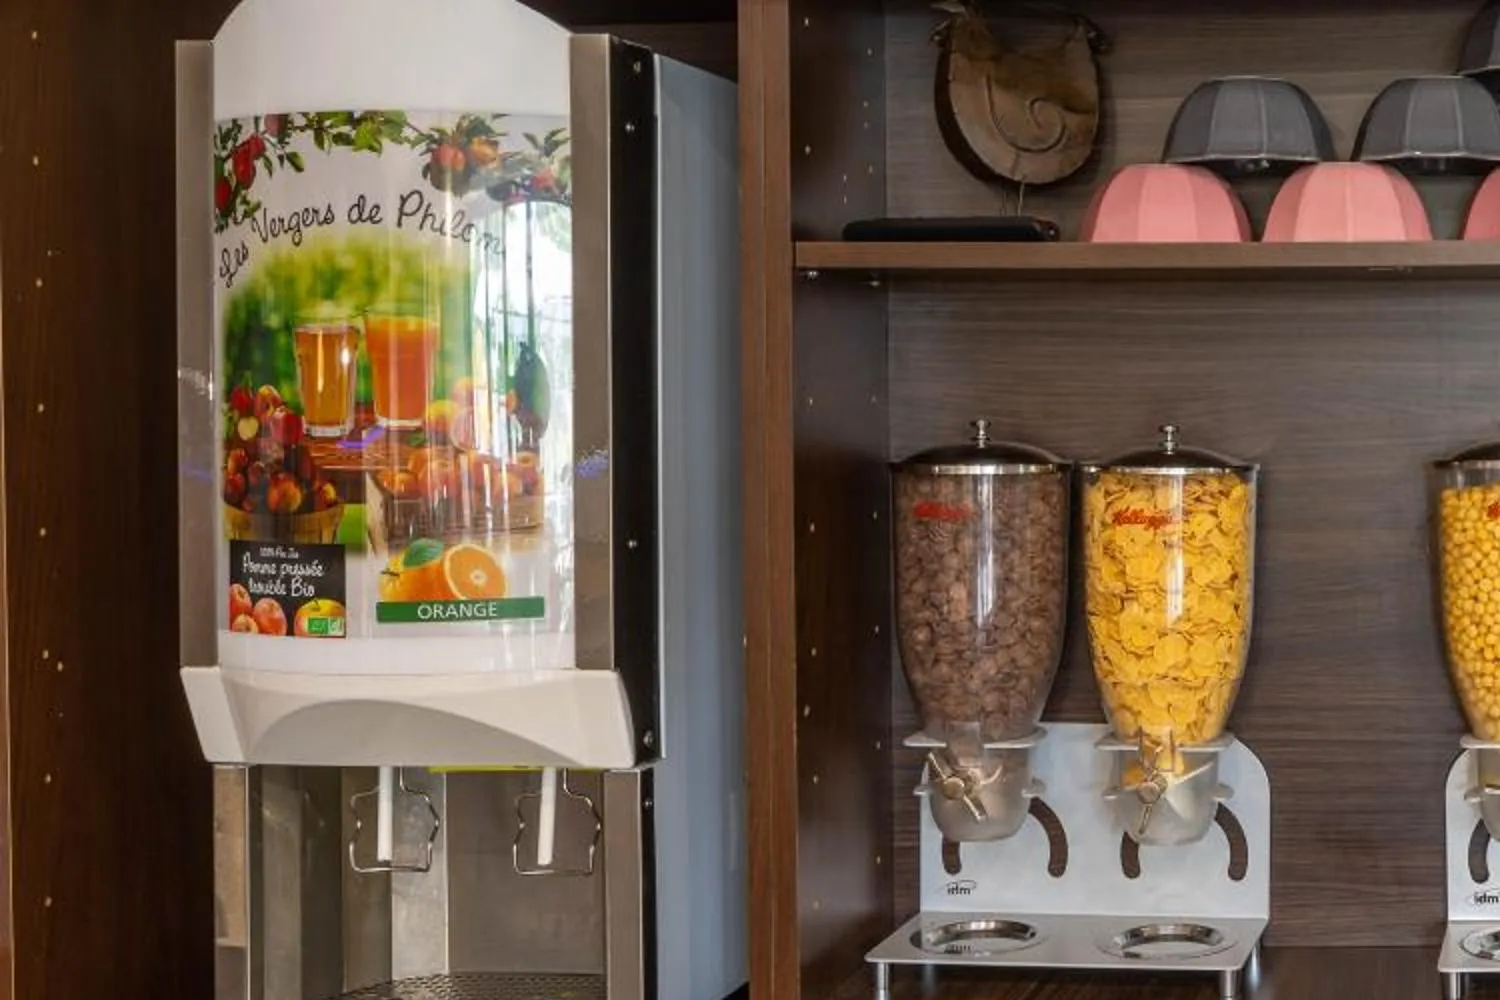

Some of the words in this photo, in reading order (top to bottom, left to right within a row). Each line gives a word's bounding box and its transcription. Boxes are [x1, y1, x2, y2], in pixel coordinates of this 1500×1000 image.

[219, 241, 249, 288] Les
[251, 203, 335, 247] Vergers
[348, 194, 383, 225] de
[291, 576, 315, 597] Bio
[418, 603, 498, 620] ORANGE
